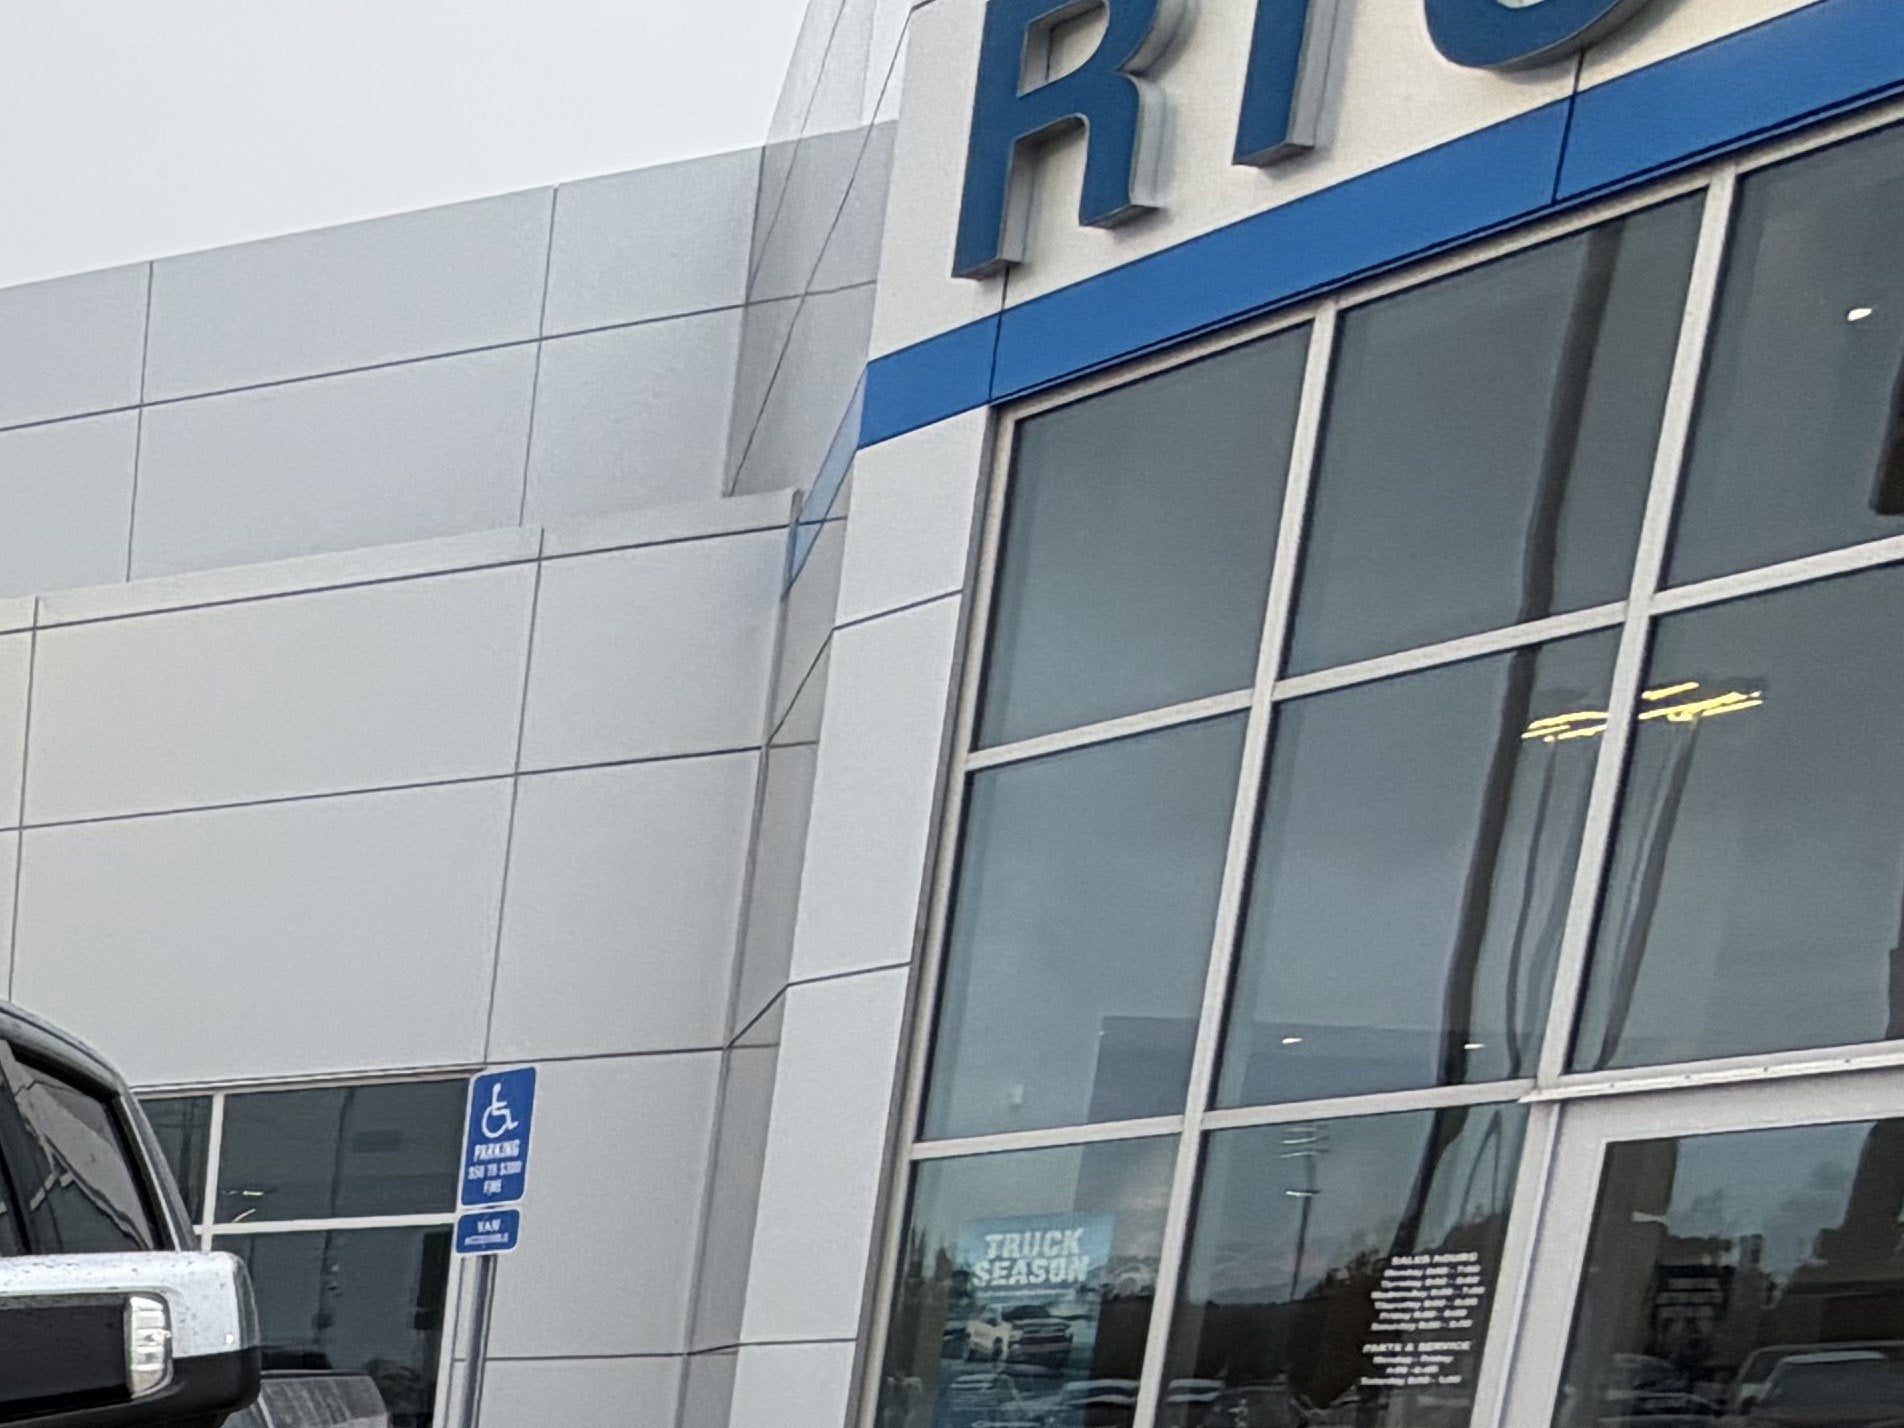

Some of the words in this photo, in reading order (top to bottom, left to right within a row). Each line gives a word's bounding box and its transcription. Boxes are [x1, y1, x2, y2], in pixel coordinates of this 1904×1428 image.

[952, 0, 1670, 279] RI
[473, 1138, 520, 1162] PARKING
[477, 1218, 502, 1234] VAN
[985, 1228, 1084, 1259] TRUCK
[972, 1255, 1090, 1287] SEASON
